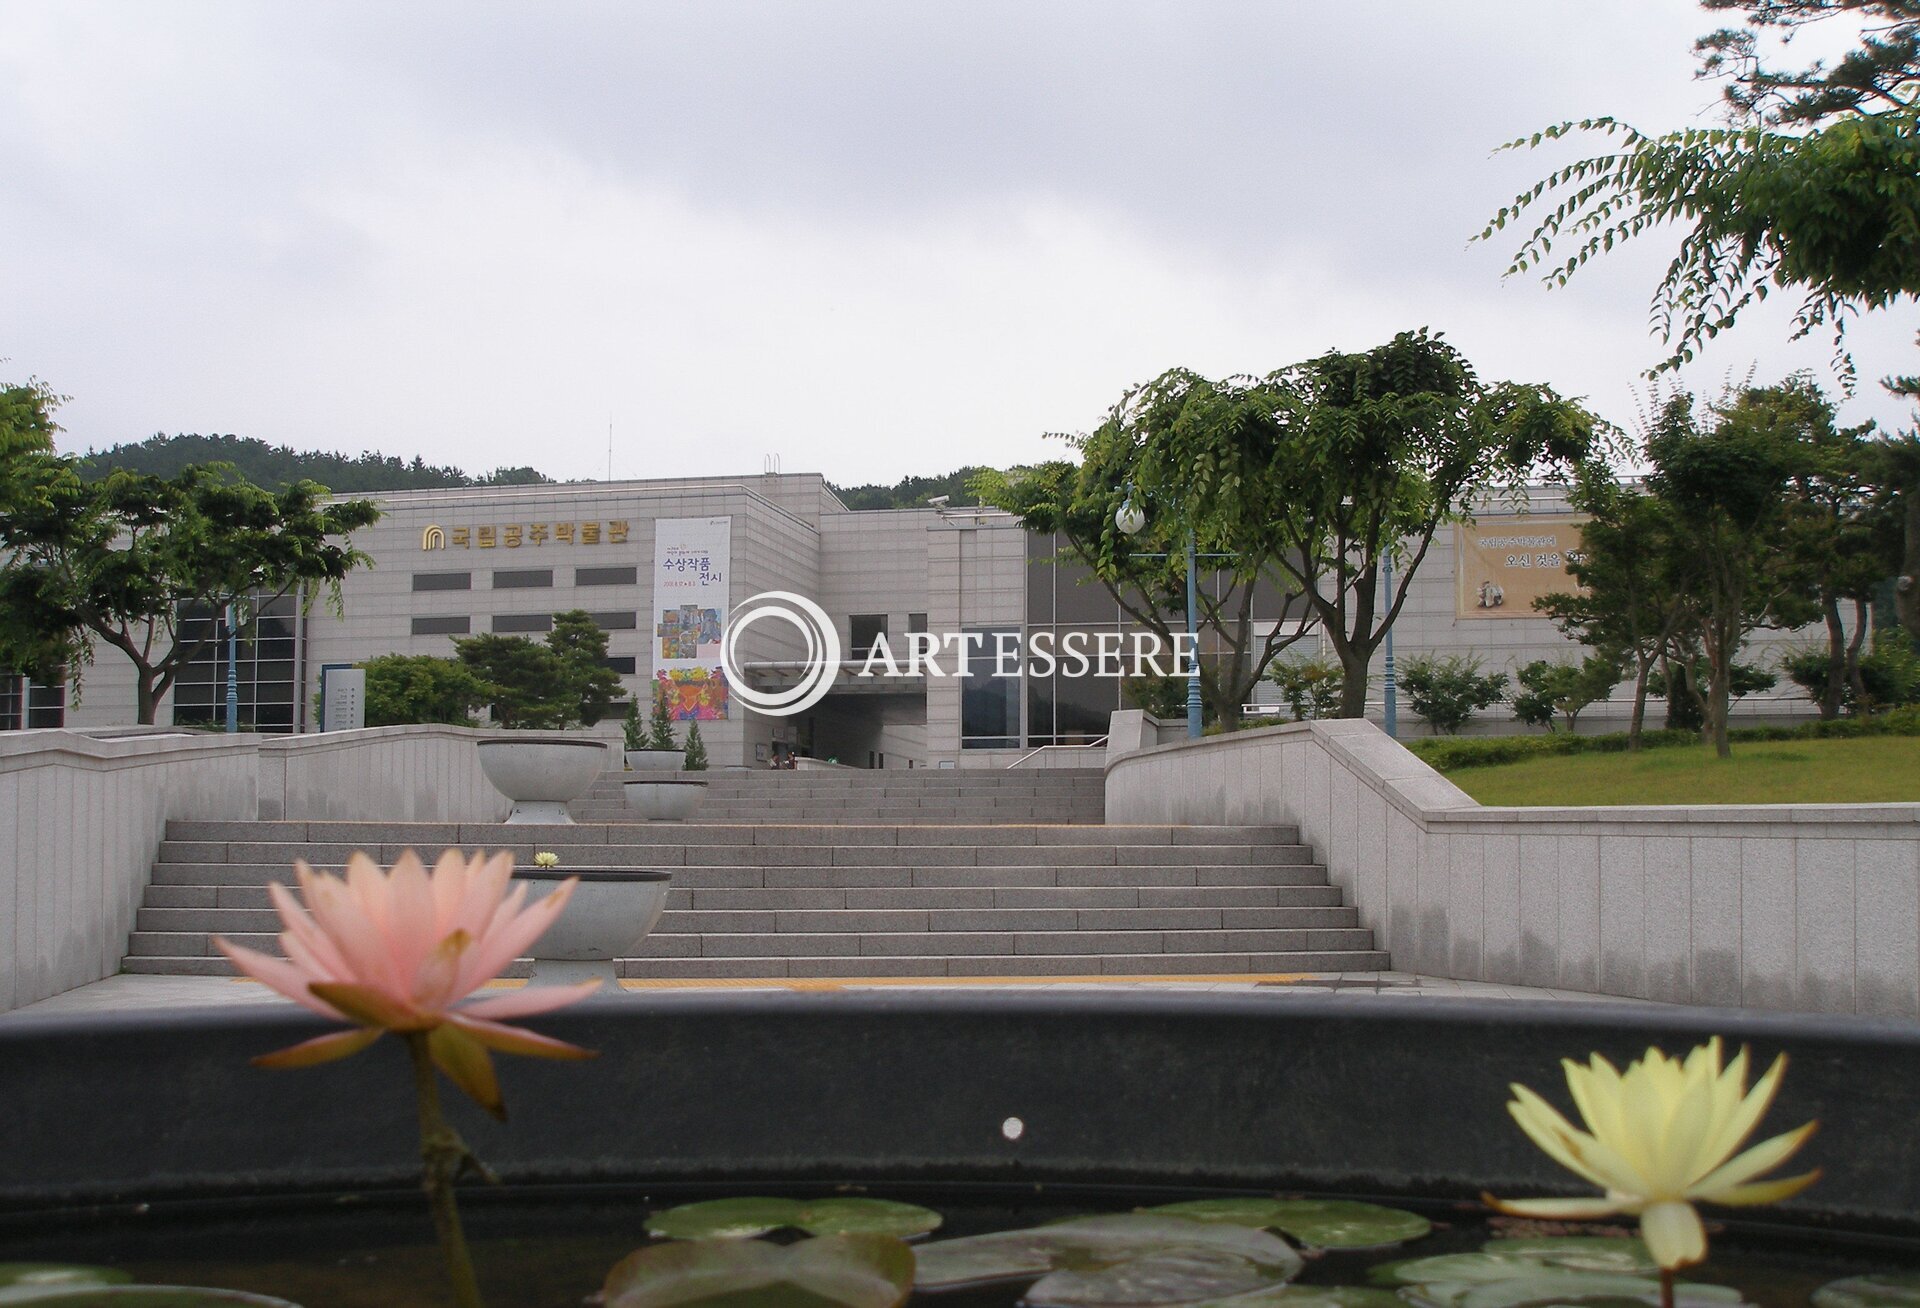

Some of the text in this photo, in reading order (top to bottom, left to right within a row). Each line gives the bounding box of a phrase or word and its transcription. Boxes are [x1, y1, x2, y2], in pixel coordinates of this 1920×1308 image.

[452, 519, 629, 549] 국립공주박물관
[663, 557, 711, 572] 수상작품
[1505, 553, 1531, 567] 오신
[1535, 552, 1561, 567] 것을
[699, 572, 722, 586] 전시
